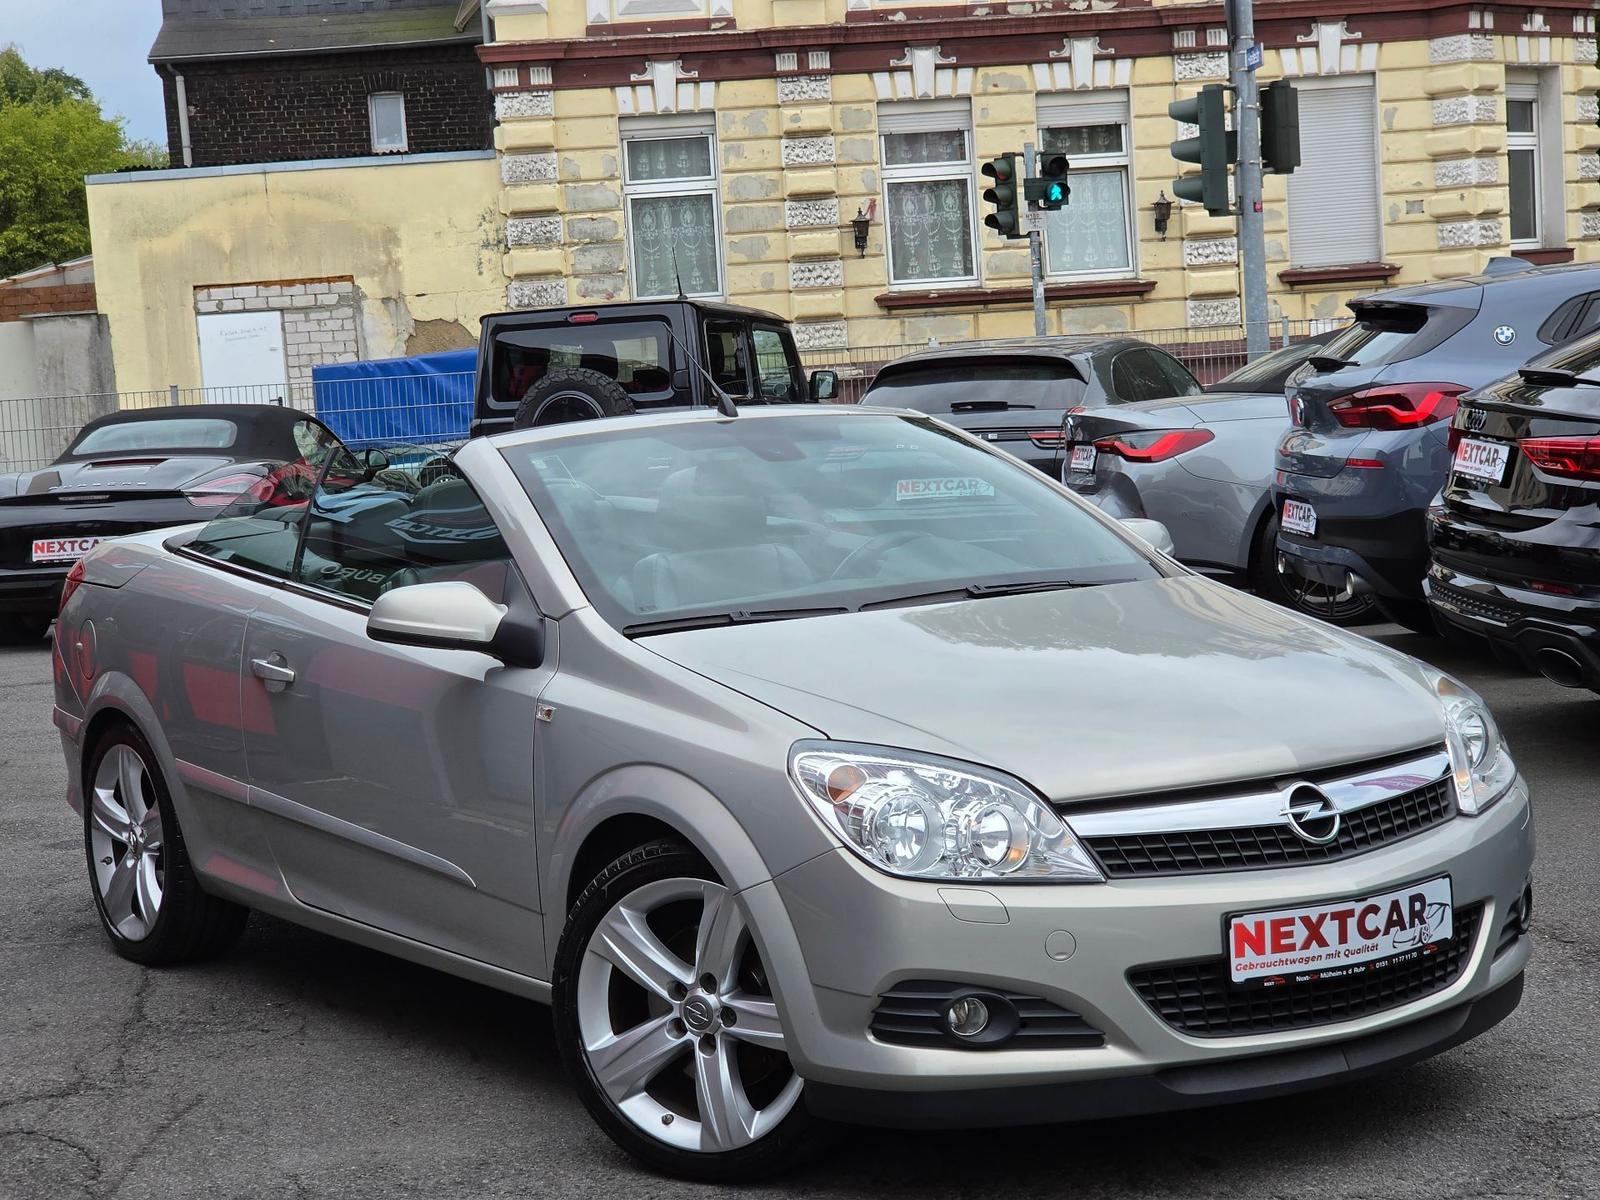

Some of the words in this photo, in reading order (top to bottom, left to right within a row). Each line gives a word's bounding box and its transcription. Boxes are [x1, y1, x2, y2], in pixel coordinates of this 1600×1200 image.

[1456, 442, 1499, 467] NEXTCAR
[900, 480, 979, 493] NEXTCAR
[34, 539, 104, 553] NEXTCA
[1233, 893, 1427, 958] NEXTCAR
[1235, 954, 1322, 972] Gebrauchtwagen
[1325, 950, 1341, 960] mit
[1344, 943, 1379, 958] Qualität
[1320, 970, 1342, 979] Mülheim
